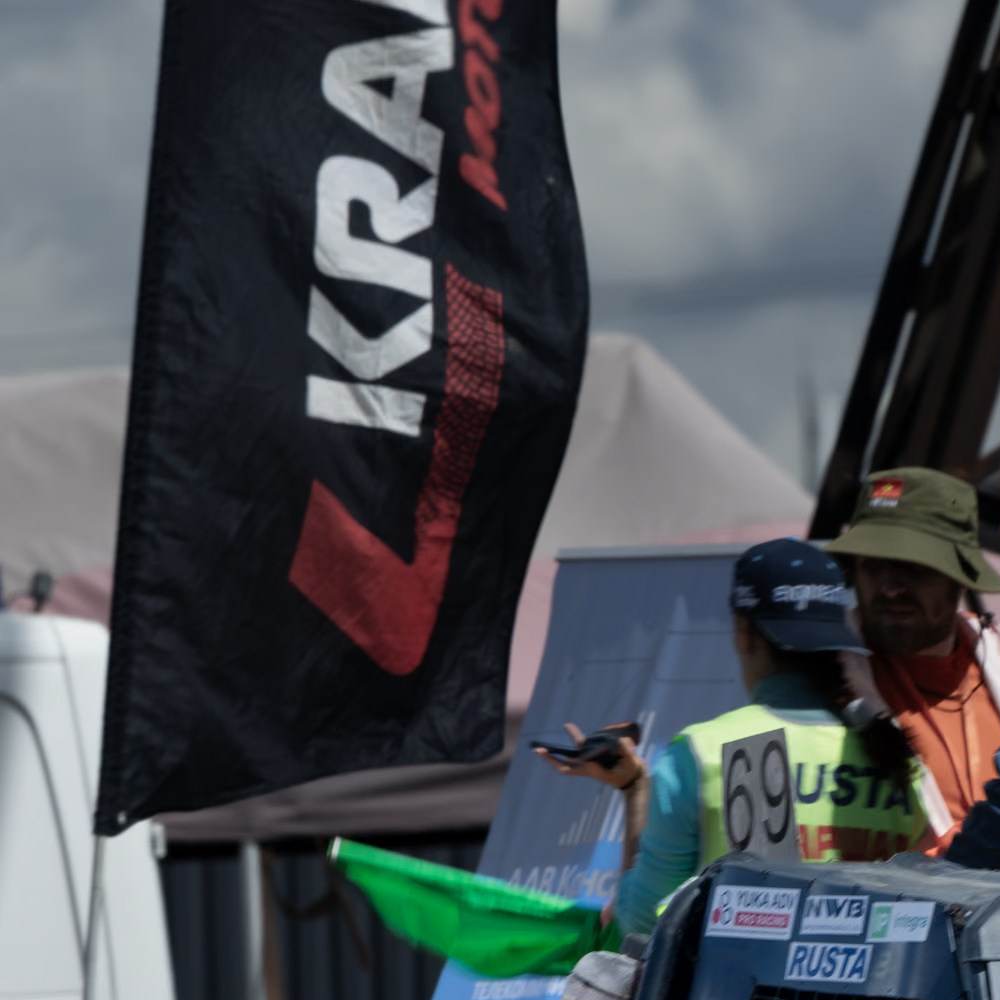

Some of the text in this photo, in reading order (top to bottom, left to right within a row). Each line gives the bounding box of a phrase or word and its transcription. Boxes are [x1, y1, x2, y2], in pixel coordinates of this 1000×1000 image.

[305, 0, 454, 437] KRA
[726, 739, 792, 851] 69
[796, 762, 914, 816] USTA
[804, 898, 864, 918] NWB
[789, 945, 867, 979] RUSTA
